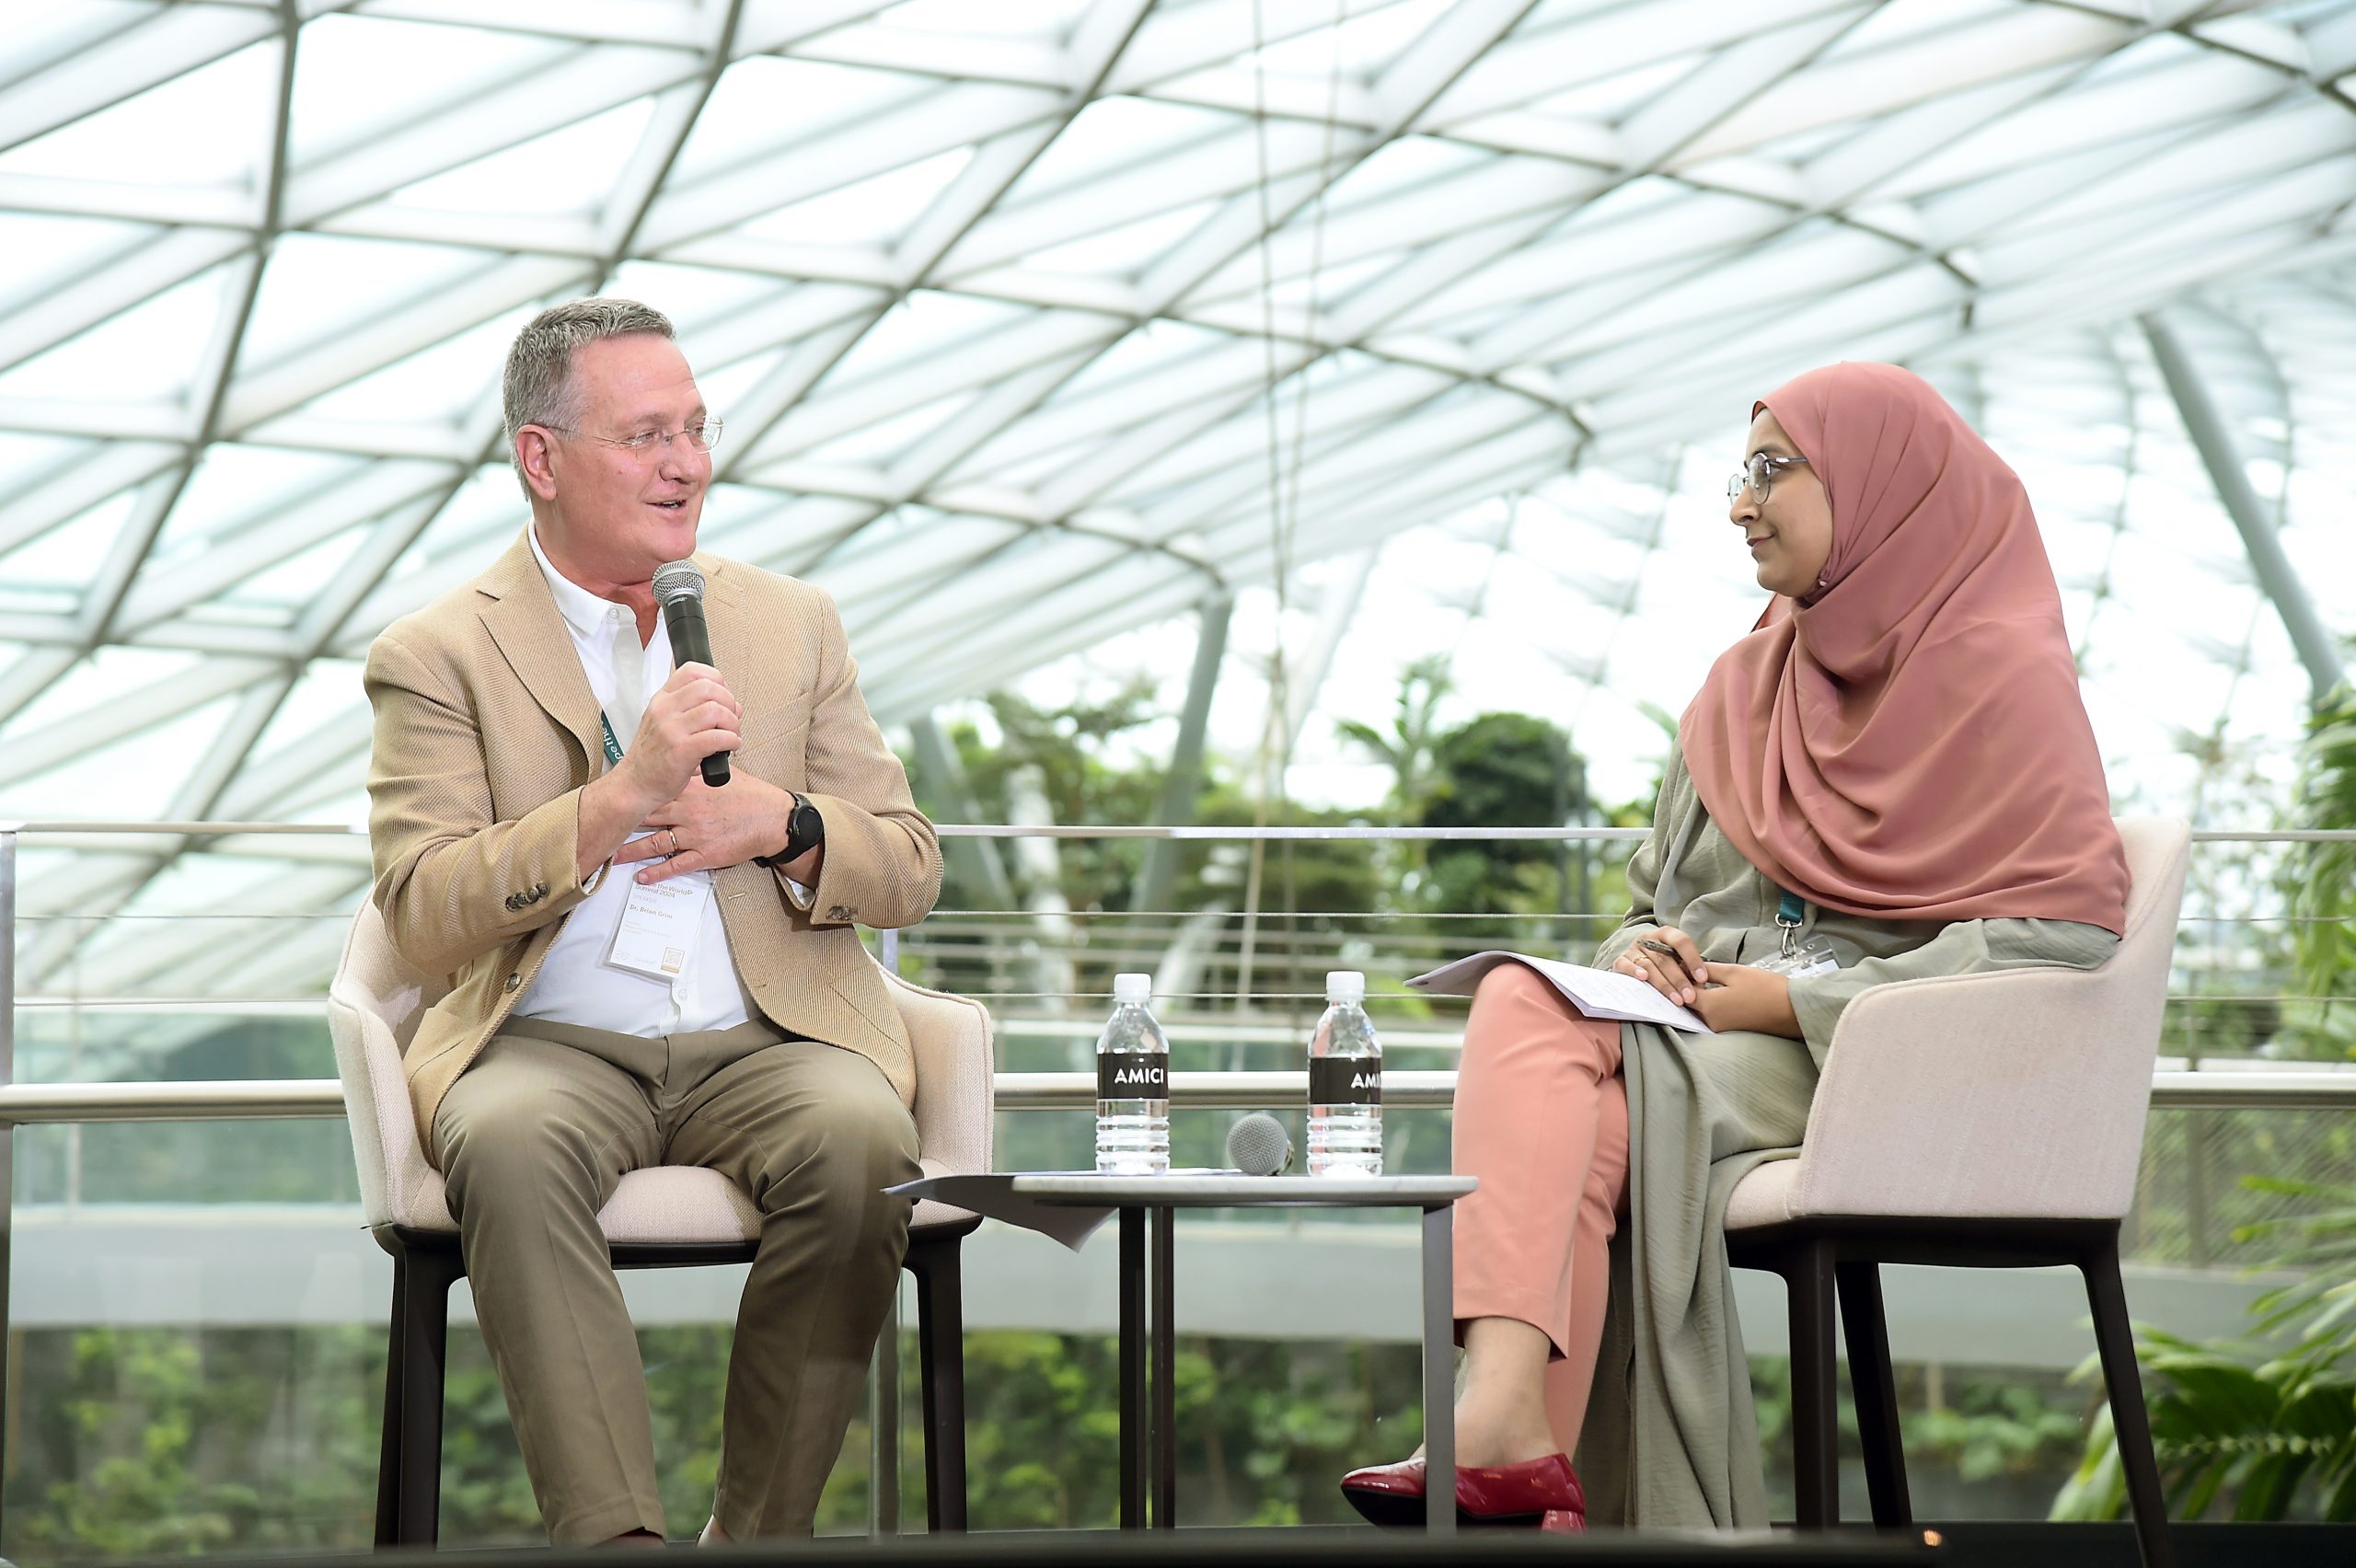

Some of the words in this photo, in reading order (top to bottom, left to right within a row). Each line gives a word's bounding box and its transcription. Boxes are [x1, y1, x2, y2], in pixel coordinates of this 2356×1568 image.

[629, 904, 639, 912] Dr.
[640, 906, 657, 916] Brian
[1114, 1067, 1164, 1084] AMICI
